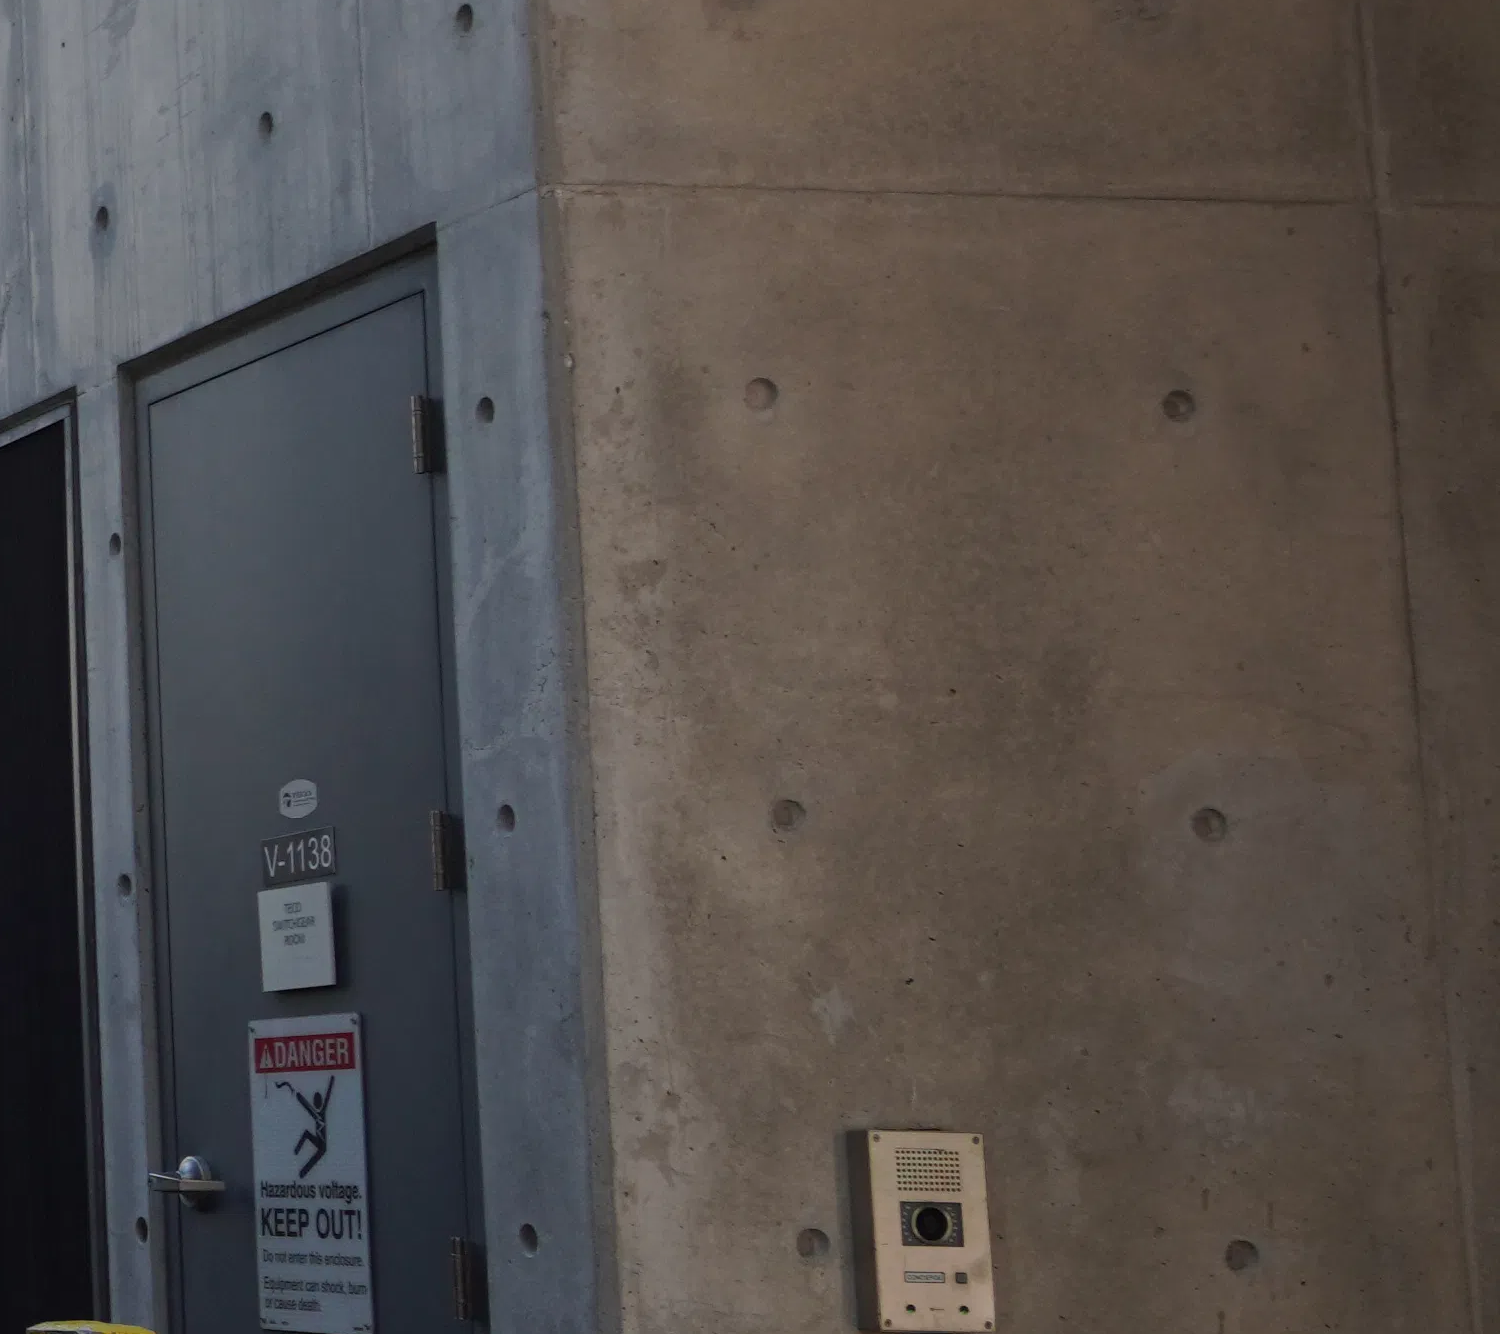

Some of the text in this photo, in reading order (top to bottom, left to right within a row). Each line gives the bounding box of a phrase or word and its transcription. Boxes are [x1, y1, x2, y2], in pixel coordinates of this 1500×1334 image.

[264, 834, 332, 878] V-1138
[274, 1038, 349, 1067] DANGER
[261, 1180, 362, 1204] Hazardous voltage.
[261, 1208, 362, 1240] KEEP OUT!
[263, 1249, 274, 1262] Do
[264, 1276, 304, 1294] Equipment
[305, 1282, 319, 1292] can
[274, 1299, 297, 1310] cause
